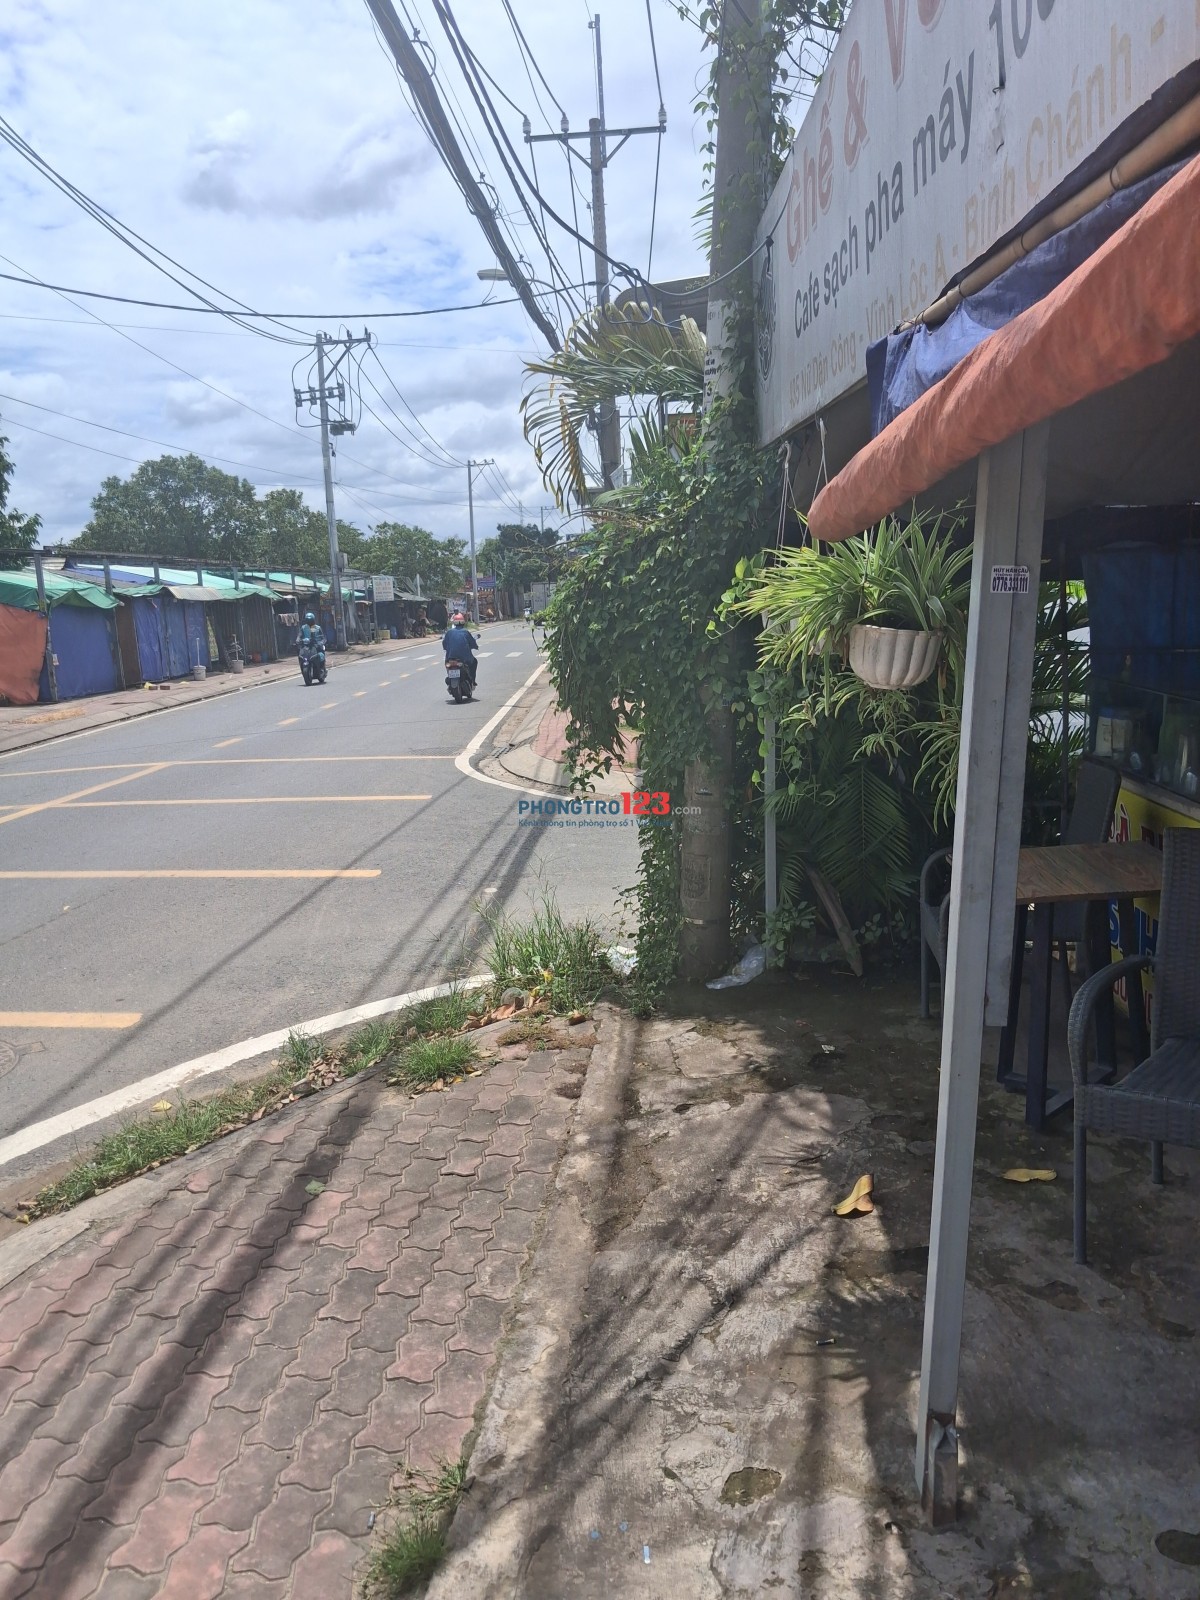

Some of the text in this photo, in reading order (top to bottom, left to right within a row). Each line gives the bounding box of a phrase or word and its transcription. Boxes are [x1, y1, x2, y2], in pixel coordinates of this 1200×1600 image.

[795, 270, 820, 338] Cafe
[824, 215, 858, 310] sạch
[864, 160, 905, 275] pha
[912, 49, 976, 198] máy
[843, 39, 870, 172] &
[934, 232, 948, 292] A
[965, 152, 1016, 261] Bình
[1025, 22, 1132, 197] Chánh
